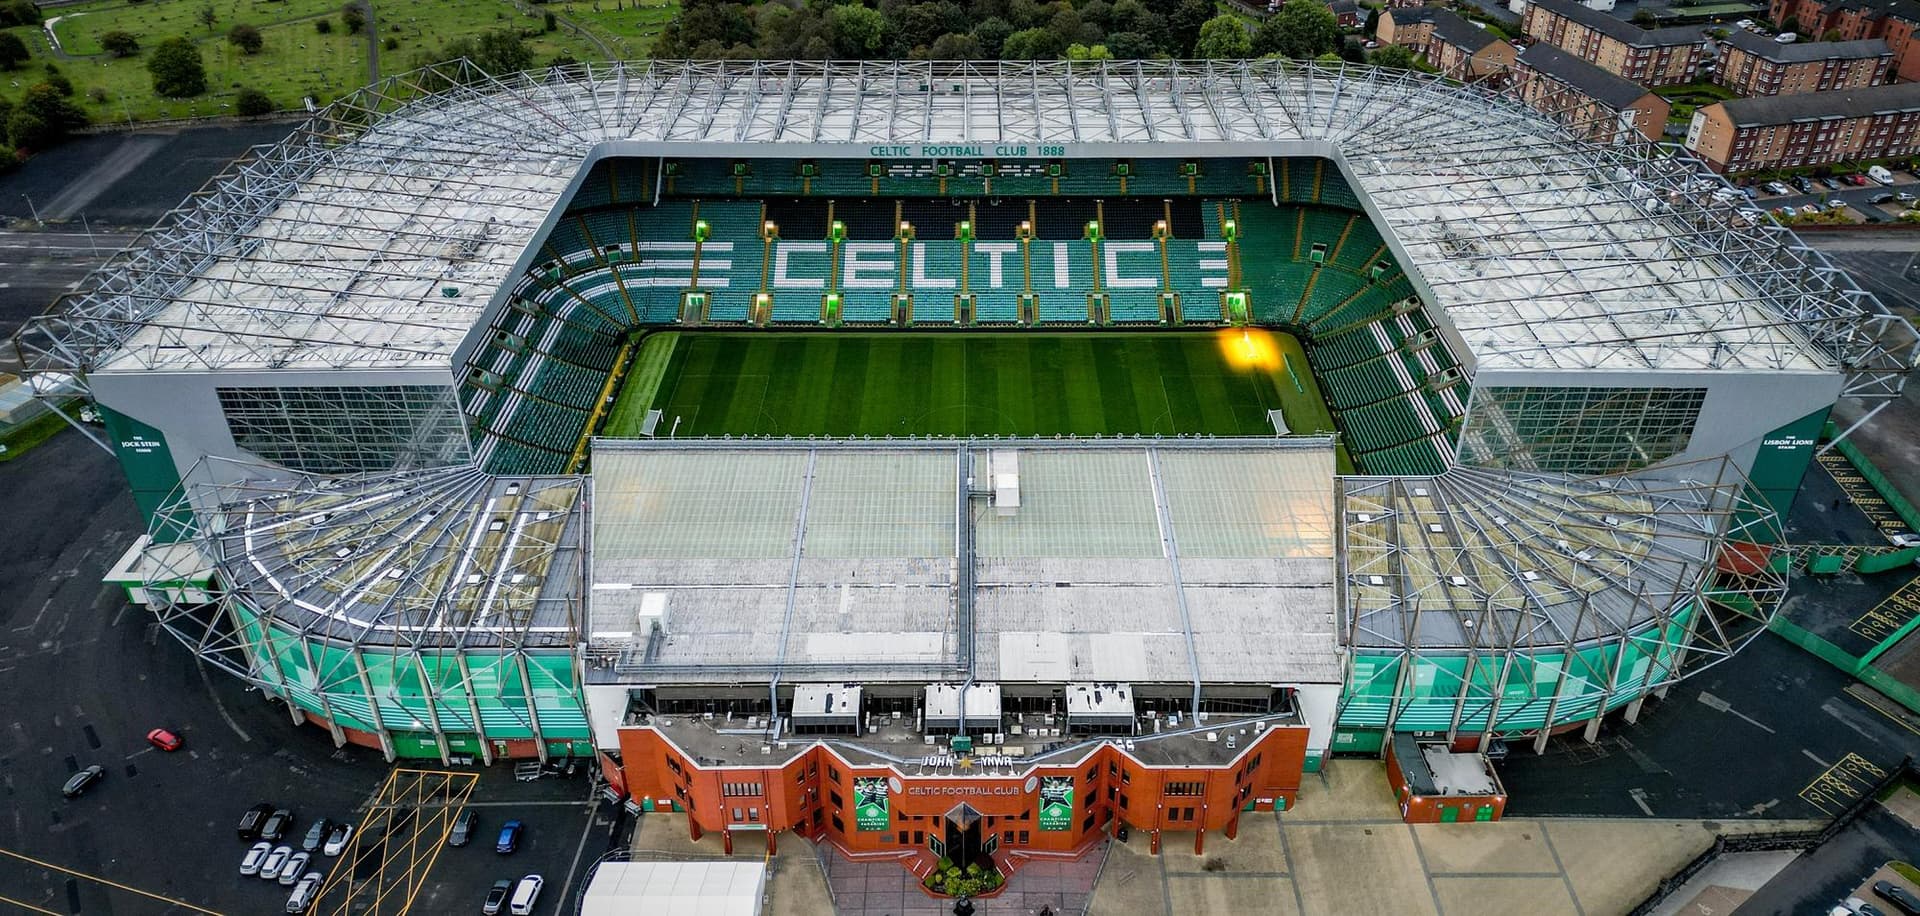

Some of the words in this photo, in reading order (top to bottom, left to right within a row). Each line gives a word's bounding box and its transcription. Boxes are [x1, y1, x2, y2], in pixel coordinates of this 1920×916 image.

[870, 146, 911, 157] CELTIC
[922, 146, 984, 157] FOOTBALL
[995, 146, 1028, 157] CLUB
[1037, 146, 1065, 156] 1888
[773, 241, 1158, 288] CELTIC
[922, 755, 953, 767] JOHN
[908, 786, 940, 796] CELTIC
[942, 786, 993, 796] FOOTBALL
[994, 786, 1020, 796] CLUB
